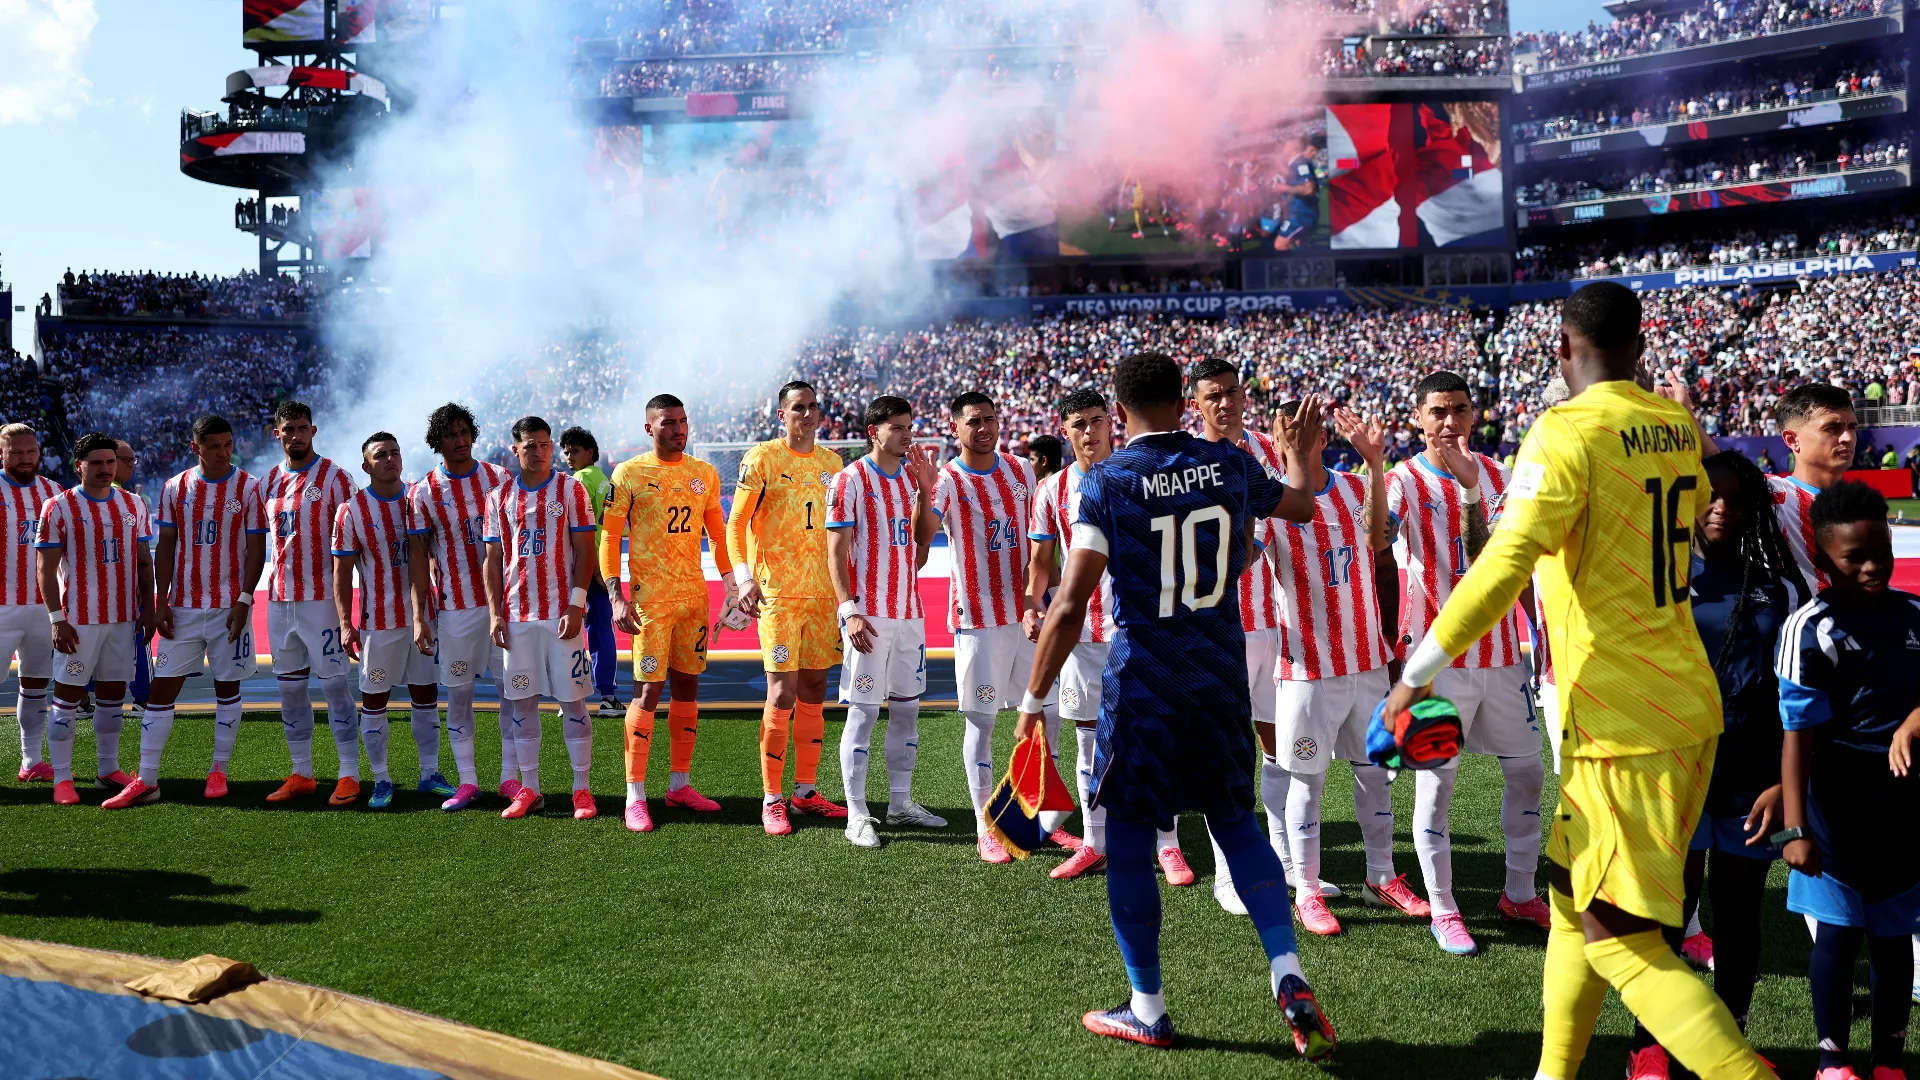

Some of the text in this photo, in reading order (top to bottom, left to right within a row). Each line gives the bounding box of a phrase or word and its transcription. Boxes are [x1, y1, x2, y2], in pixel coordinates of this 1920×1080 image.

[752, 95, 785, 109] FRANCE
[1574, 204, 1604, 219] FRANCE
[1674, 255, 1875, 285] PHILADELPHIA
[1066, 300, 1106, 314] FIFA
[1183, 296, 1222, 312] CUP
[1224, 295, 1293, 311] 2026
[1620, 424, 1697, 458] MAIGNAN
[1142, 463, 1224, 500] MBAPPE
[278, 511, 296, 537] 21
[667, 506, 691, 533] 22
[805, 501, 814, 530] 1
[194, 520, 217, 545] 18
[519, 529, 545, 557] 26
[890, 518, 909, 546] 16
[989, 516, 1017, 551] 24
[1645, 475, 1697, 609] 16
[101, 538, 120, 563] 11
[1150, 505, 1231, 618] 10
[1453, 536, 1467, 575] 1
[1324, 546, 1353, 586] 17
[232, 632, 250, 661] 18
[694, 625, 707, 652] 2
[571, 650, 590, 678] 26
[916, 643, 927, 673] 1
